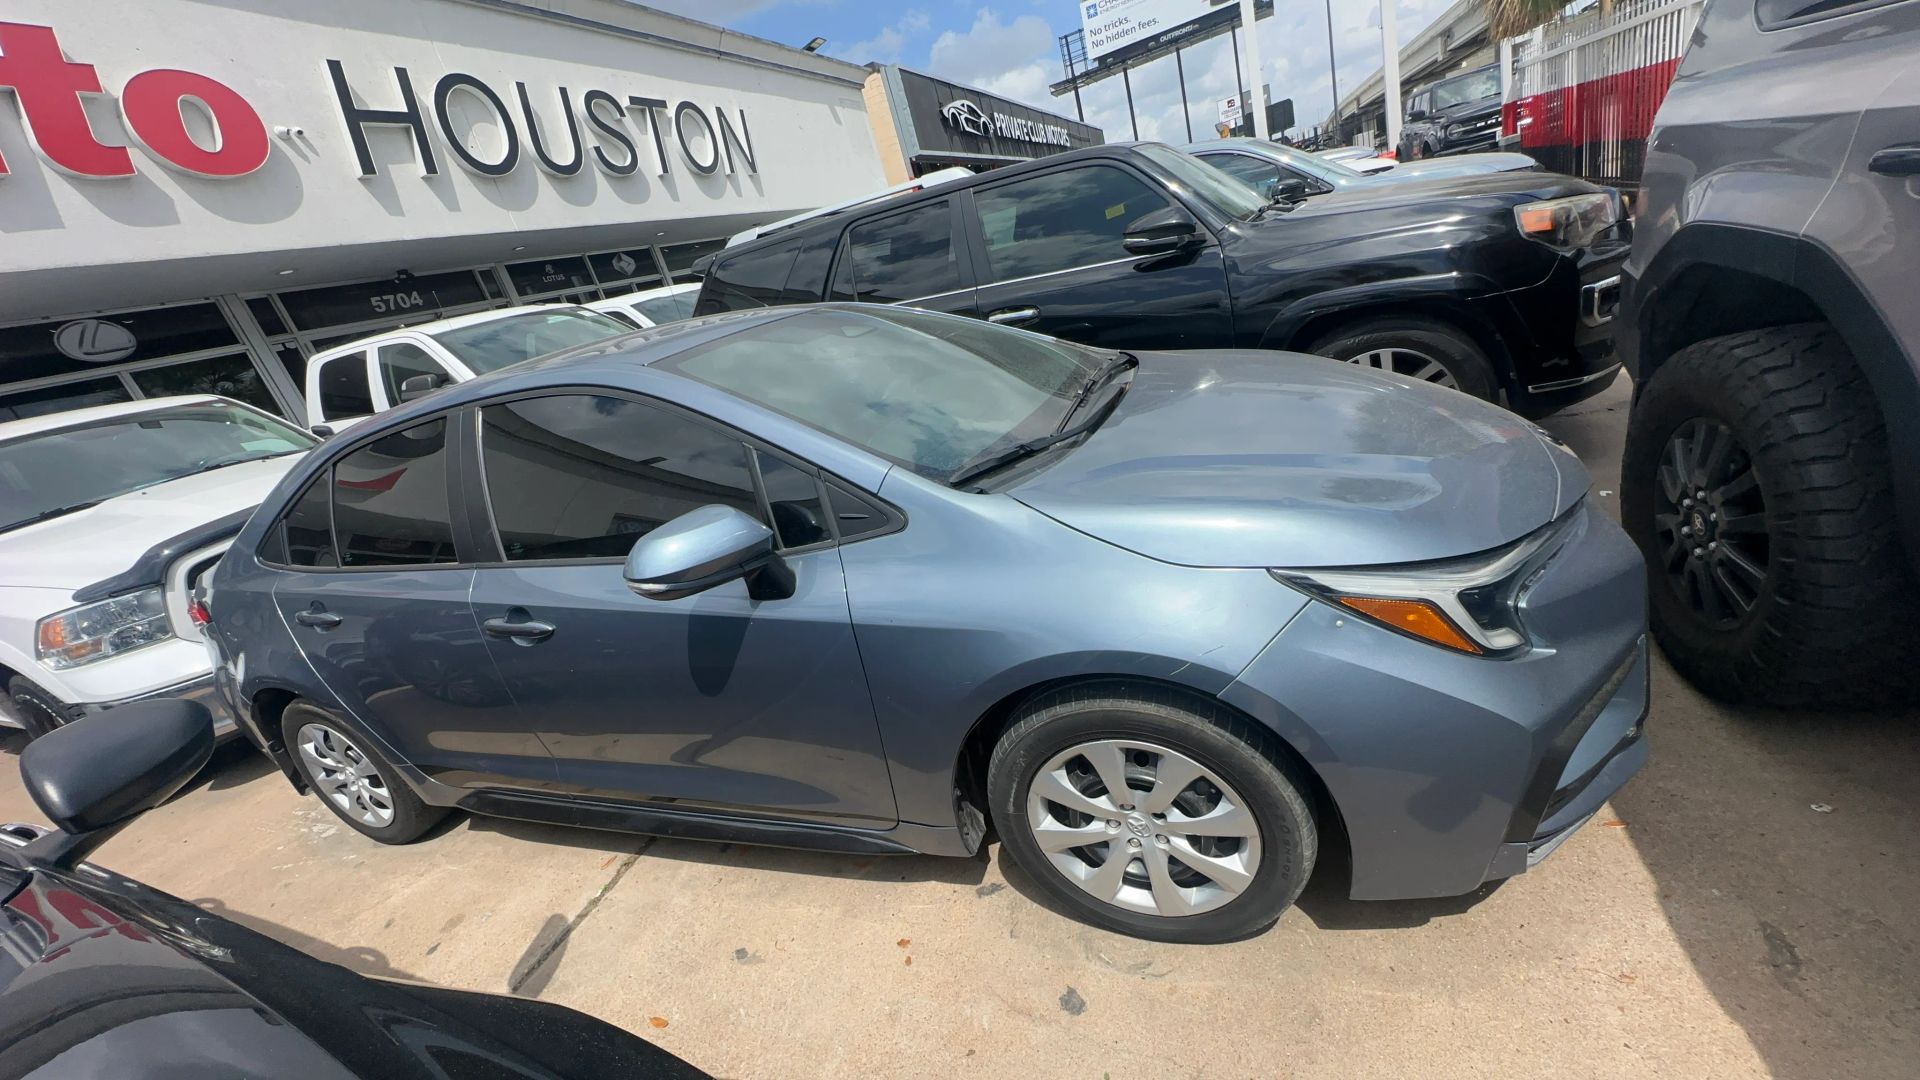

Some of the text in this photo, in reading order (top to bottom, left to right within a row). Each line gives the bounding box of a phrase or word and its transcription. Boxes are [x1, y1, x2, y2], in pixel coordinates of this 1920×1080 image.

[1089, 16, 1131, 37] No tricks.
[1091, 18, 1160, 48] No hidden fees.
[0, 21, 758, 180] to HOUSTON
[993, 112, 1070, 147] PRIVATE CLUB MOTORS
[542, 273, 565, 282] LOTUS
[370, 290, 424, 313] 5704
